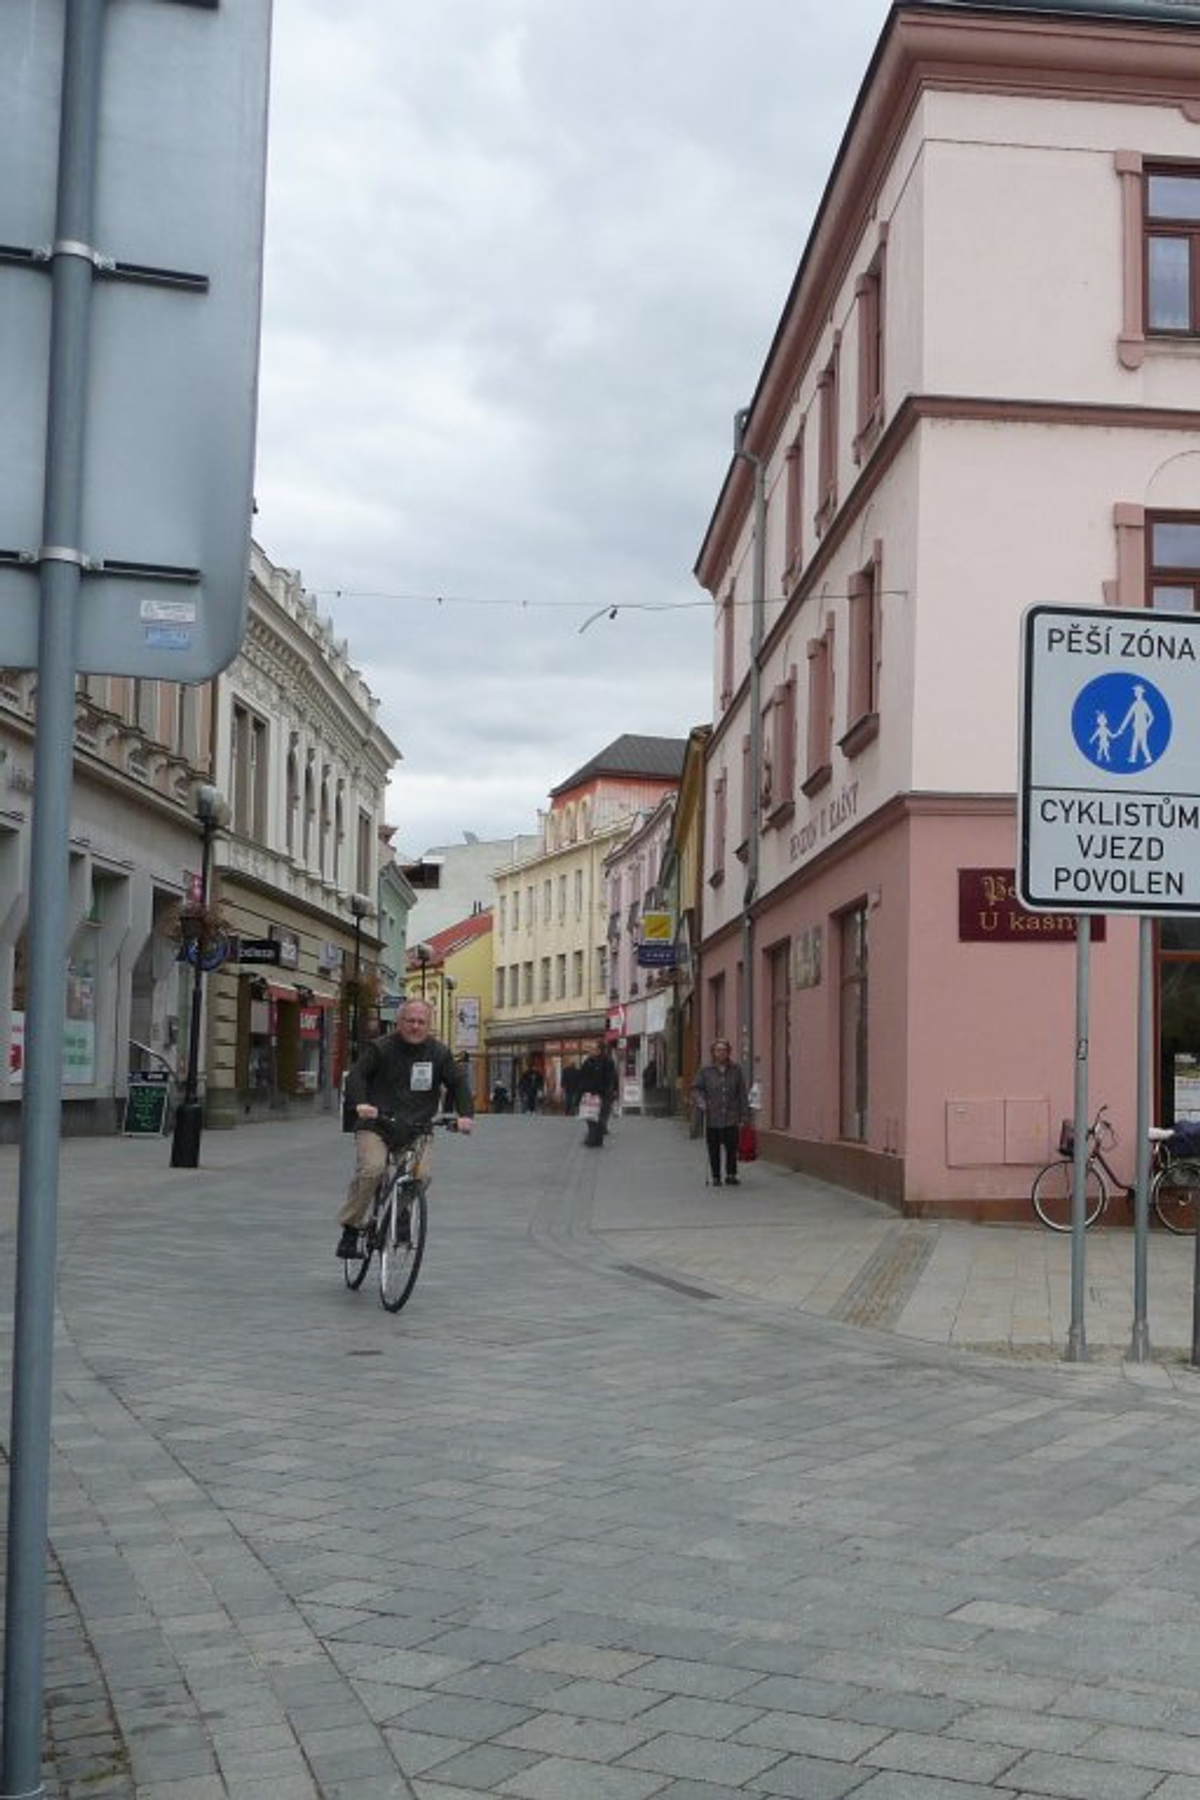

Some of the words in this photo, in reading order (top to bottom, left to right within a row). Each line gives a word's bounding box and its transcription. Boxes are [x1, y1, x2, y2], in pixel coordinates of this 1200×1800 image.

[1047, 624, 1112, 656] PĚŠÍ
[1120, 630, 1196, 660] ZÓNA
[1040, 797, 1199, 829] CYKLISTŮM
[1077, 835, 1164, 861] VJEZD
[1054, 867, 1184, 895] POVOLEN
[978, 911, 999, 931] U
